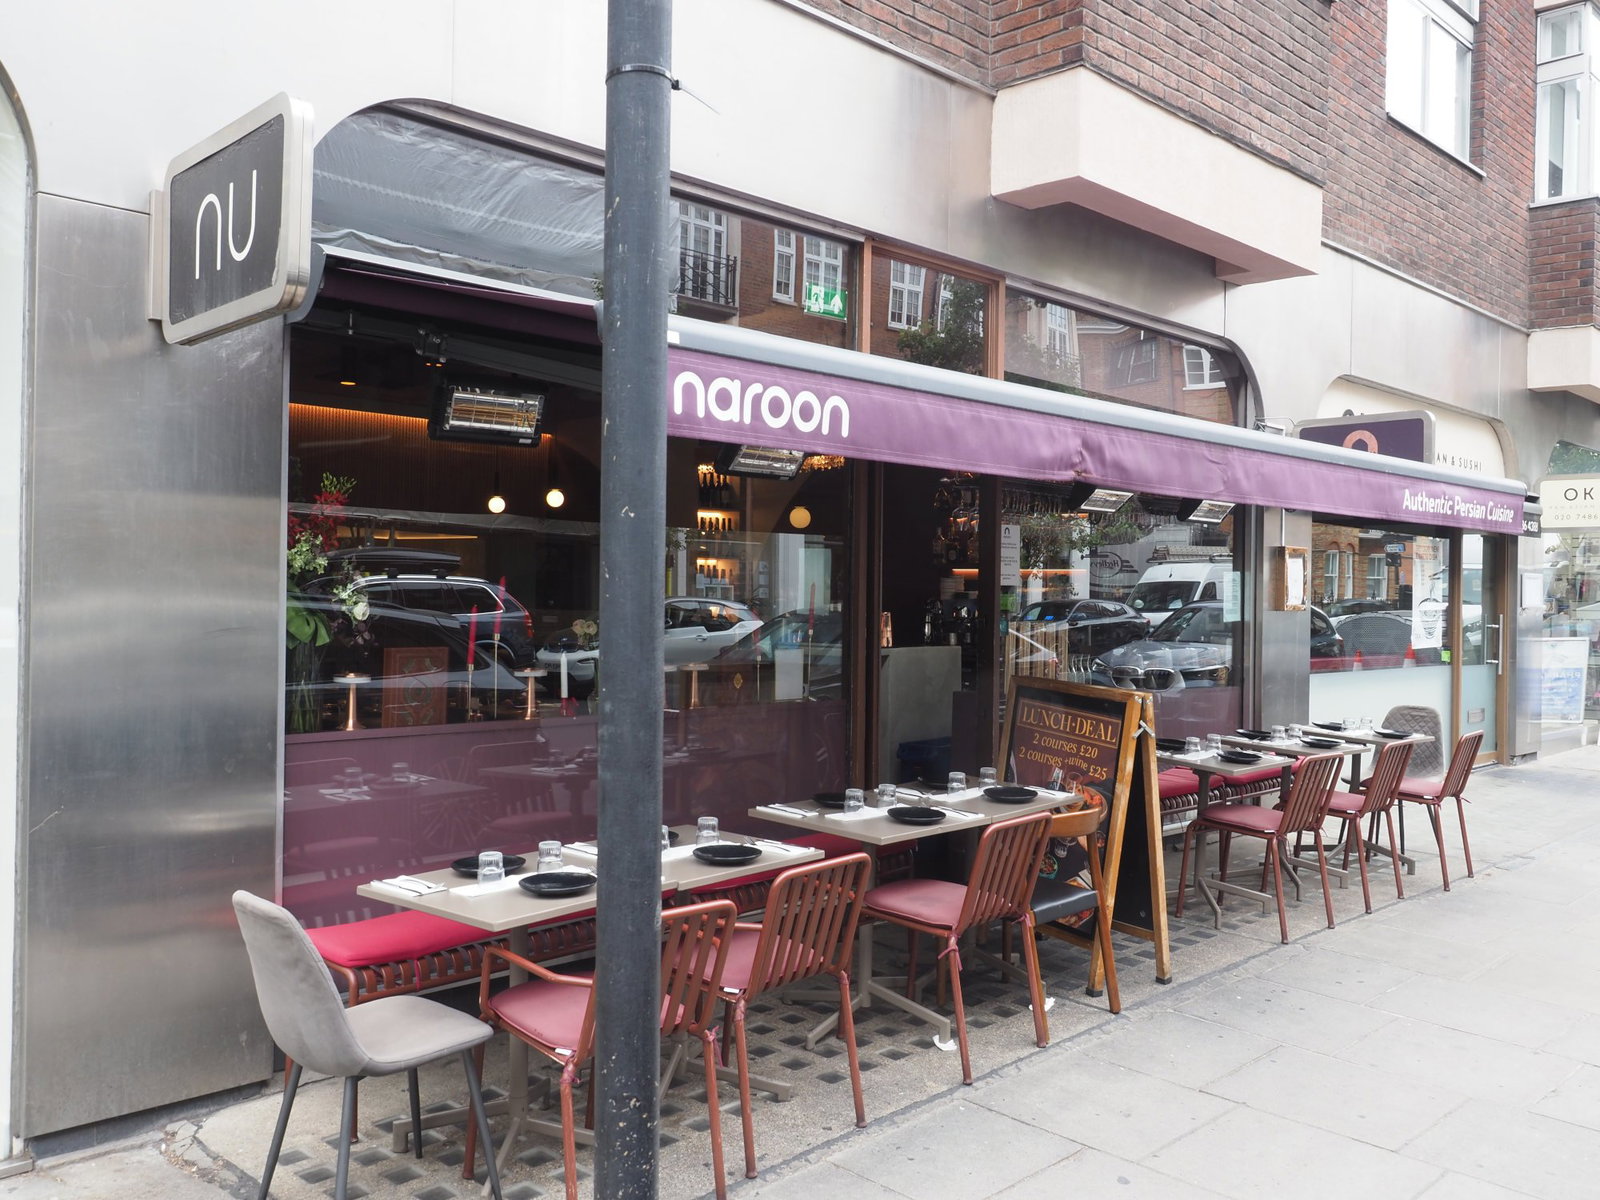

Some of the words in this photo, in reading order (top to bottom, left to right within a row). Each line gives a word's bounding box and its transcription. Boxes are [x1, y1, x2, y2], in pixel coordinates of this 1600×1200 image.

[673, 371, 850, 438] naroon
[1451, 456, 1455, 466] &
[1458, 457, 1482, 472] SUSHI
[1403, 488, 1453, 515] Authentic
[1454, 495, 1486, 520] Persian
[1487, 501, 1514, 523] Cuisine
[1564, 487, 1594, 501] OK
[1033, 733, 1040, 744] 2
[1041, 736, 1078, 754] courses
[1079, 744, 1098, 758] £20
[1019, 746, 1025, 758] 2
[1027, 749, 1062, 767] courses
[1089, 765, 1108, 780] £25
